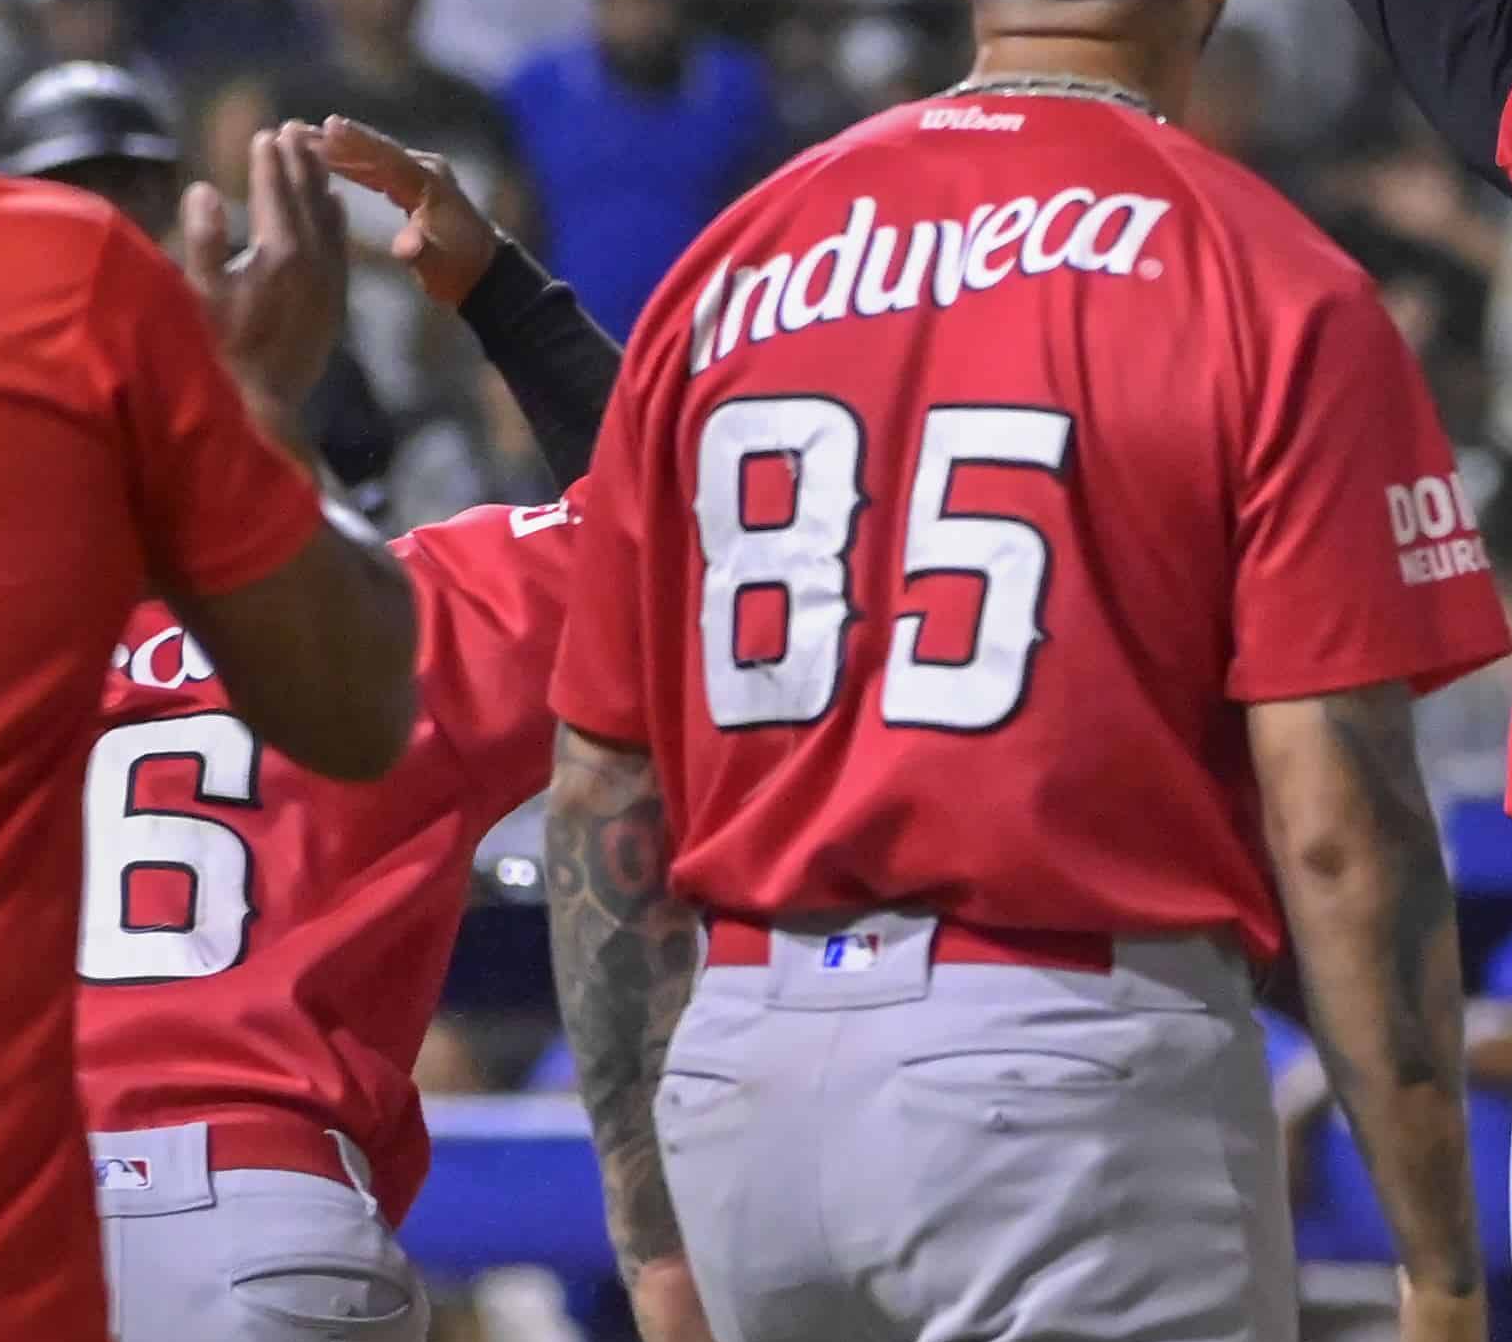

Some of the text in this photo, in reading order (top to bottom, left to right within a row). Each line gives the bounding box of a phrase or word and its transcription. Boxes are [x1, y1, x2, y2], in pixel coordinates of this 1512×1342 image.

[919, 106, 1025, 132] Wilson
[690, 187, 1172, 375] Induveca
[693, 392, 1077, 734] 85
[75, 707, 263, 988] 6
